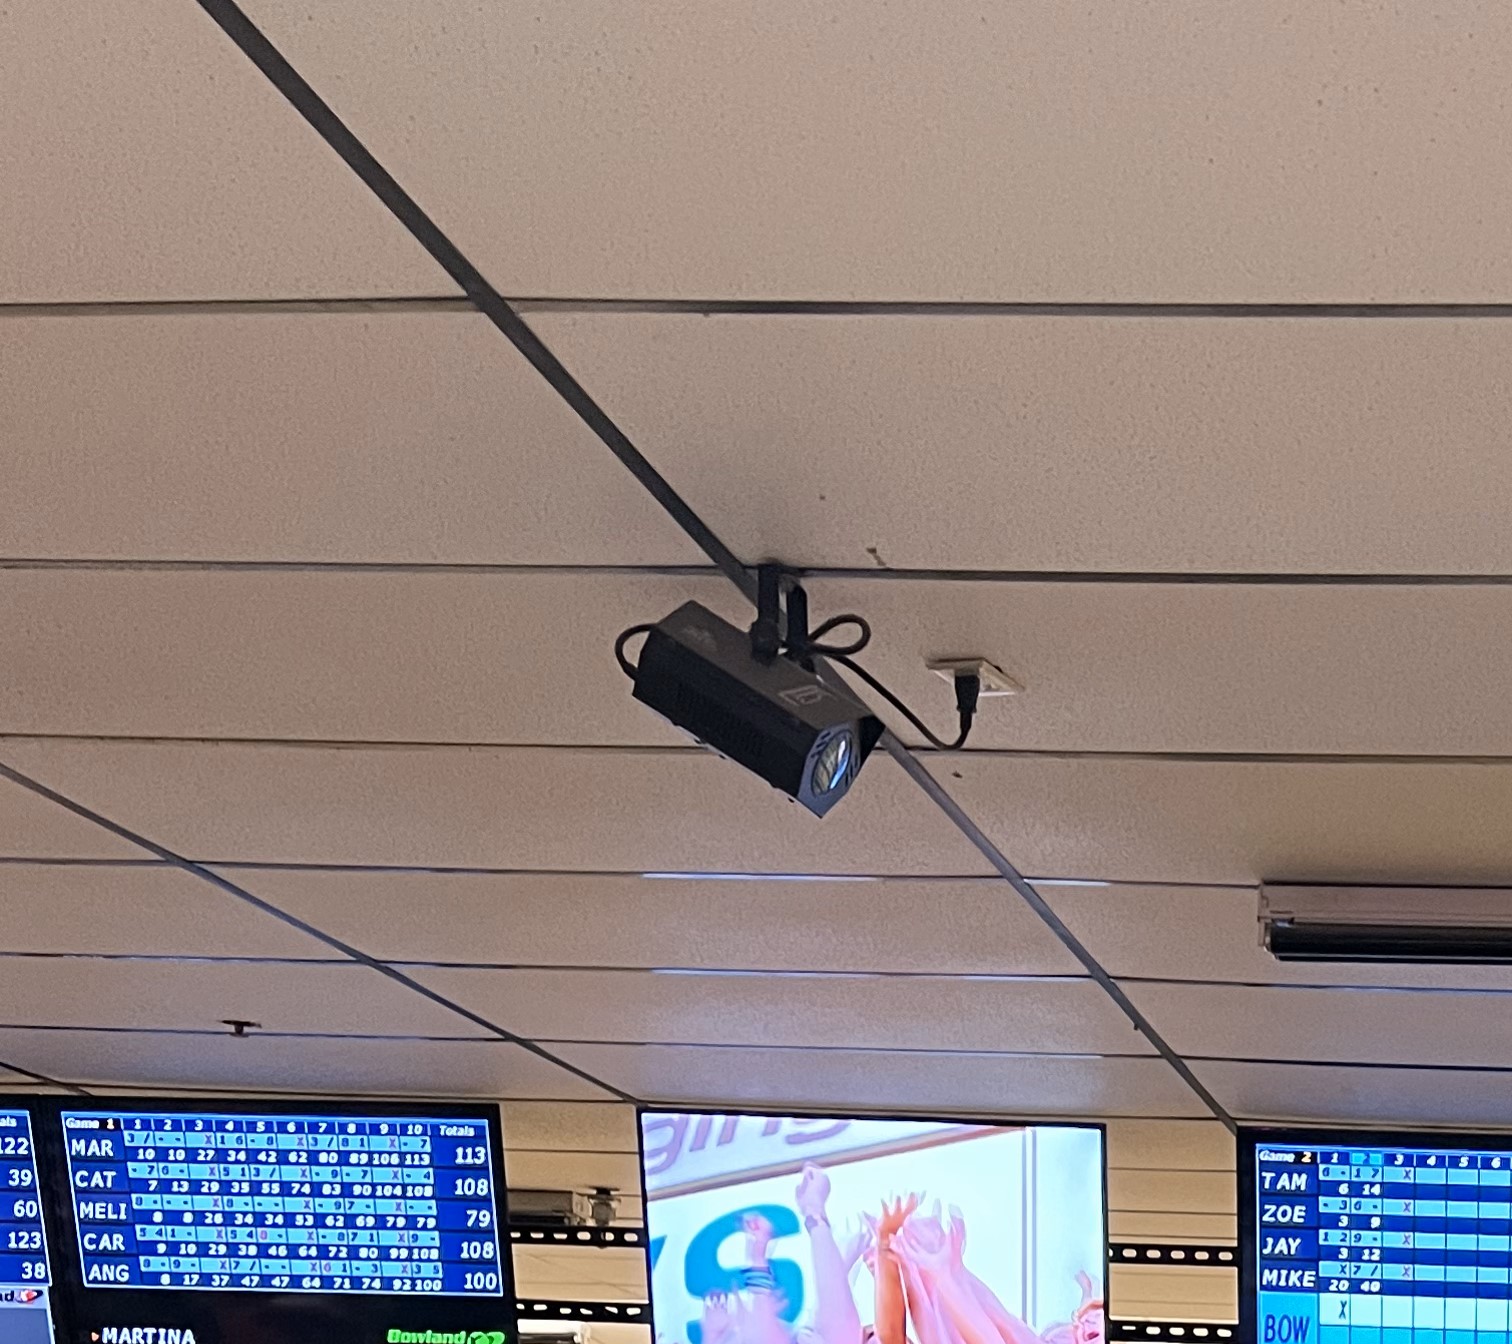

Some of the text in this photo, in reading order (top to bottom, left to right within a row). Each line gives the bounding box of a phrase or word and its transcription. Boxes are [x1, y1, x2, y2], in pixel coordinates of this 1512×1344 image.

[440, 1125, 474, 1136] Totals
[72, 1139, 486, 1164] MAR 113
[1259, 1150, 1295, 1162] Game
[1301, 1152, 1312, 1162] 2
[9, 1169, 32, 1186] 39
[75, 1170, 488, 1195] CAT 108
[1261, 1172, 1307, 1191] TAM
[14, 1200, 37, 1217] 60
[80, 1201, 491, 1227] MELI 79
[1262, 1204, 1306, 1223] ZOE
[8, 1232, 41, 1249] 123
[84, 1233, 494, 1258] CAR 108
[1262, 1237, 1302, 1255] JAY
[22, 1263, 46, 1279] 38
[88, 1264, 497, 1290] ANG 100
[1262, 1269, 1316, 1288] MIKE
[387, 1329, 466, 1344] Bowland
[1264, 1315, 1310, 1344] BOW
